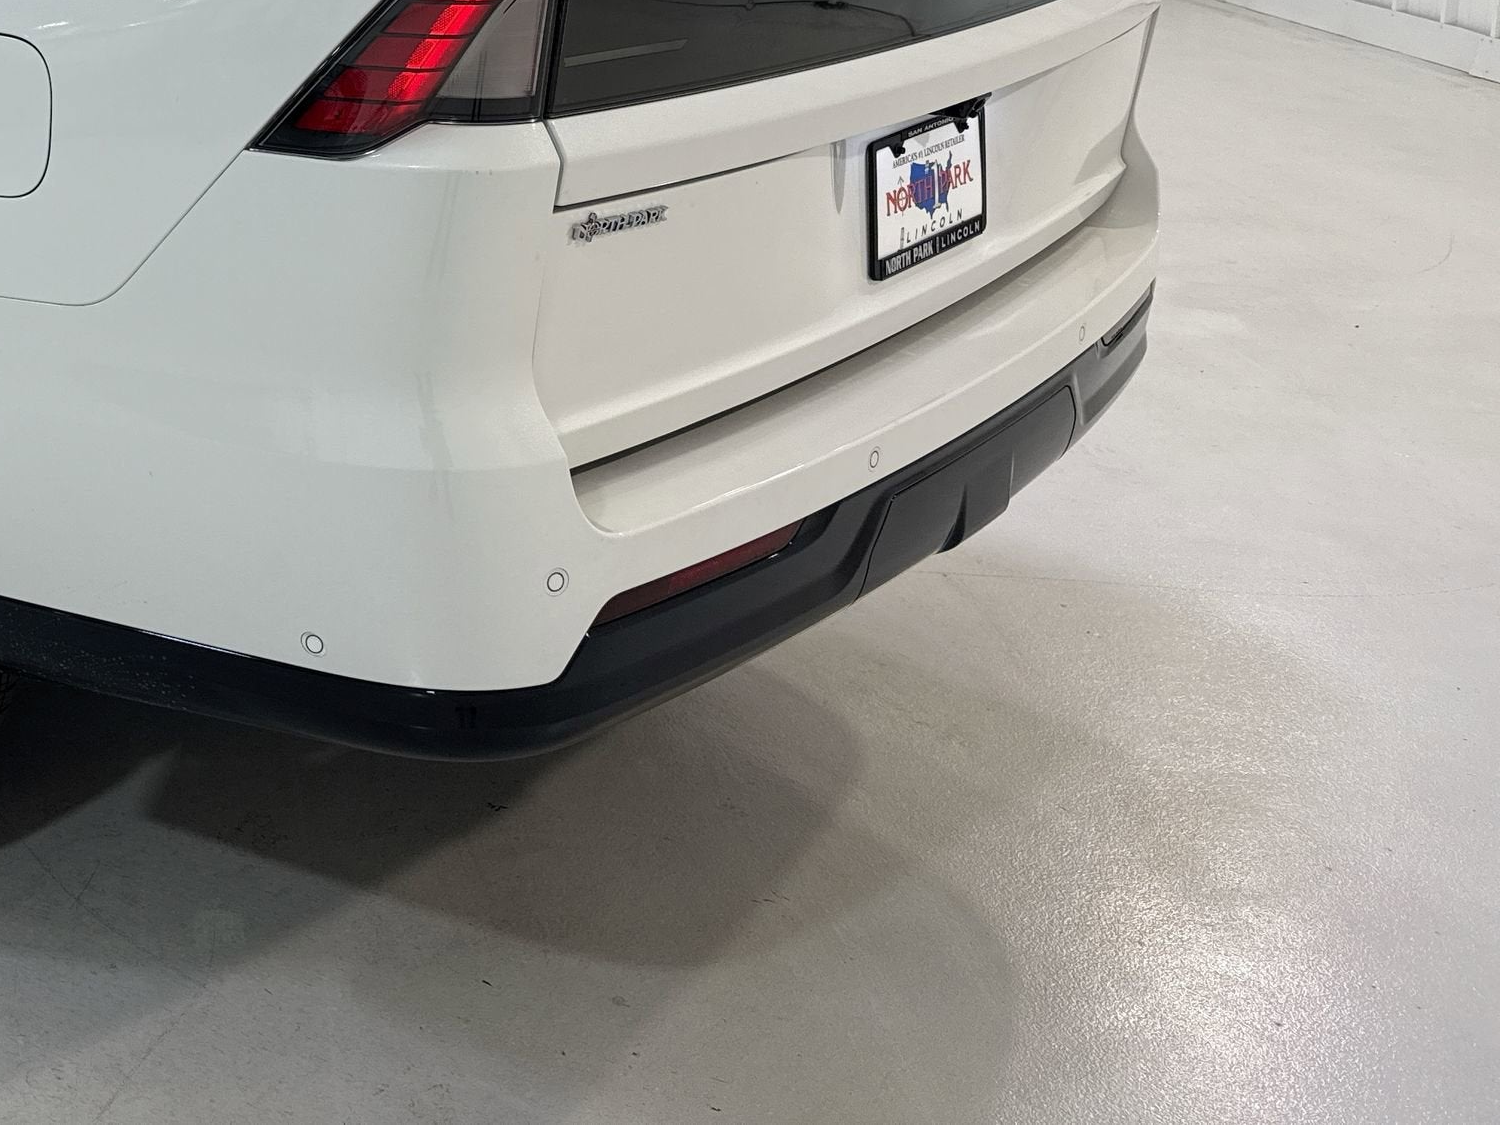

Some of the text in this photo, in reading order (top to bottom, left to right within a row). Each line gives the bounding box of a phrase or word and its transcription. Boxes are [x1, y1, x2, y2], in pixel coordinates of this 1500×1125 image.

[908, 117, 954, 138] SAN ANTONIO
[885, 159, 974, 216] NORTH PARK
[885, 220, 980, 275] NORTH PARK LINCOLN
[906, 208, 962, 244] LINCOLN
